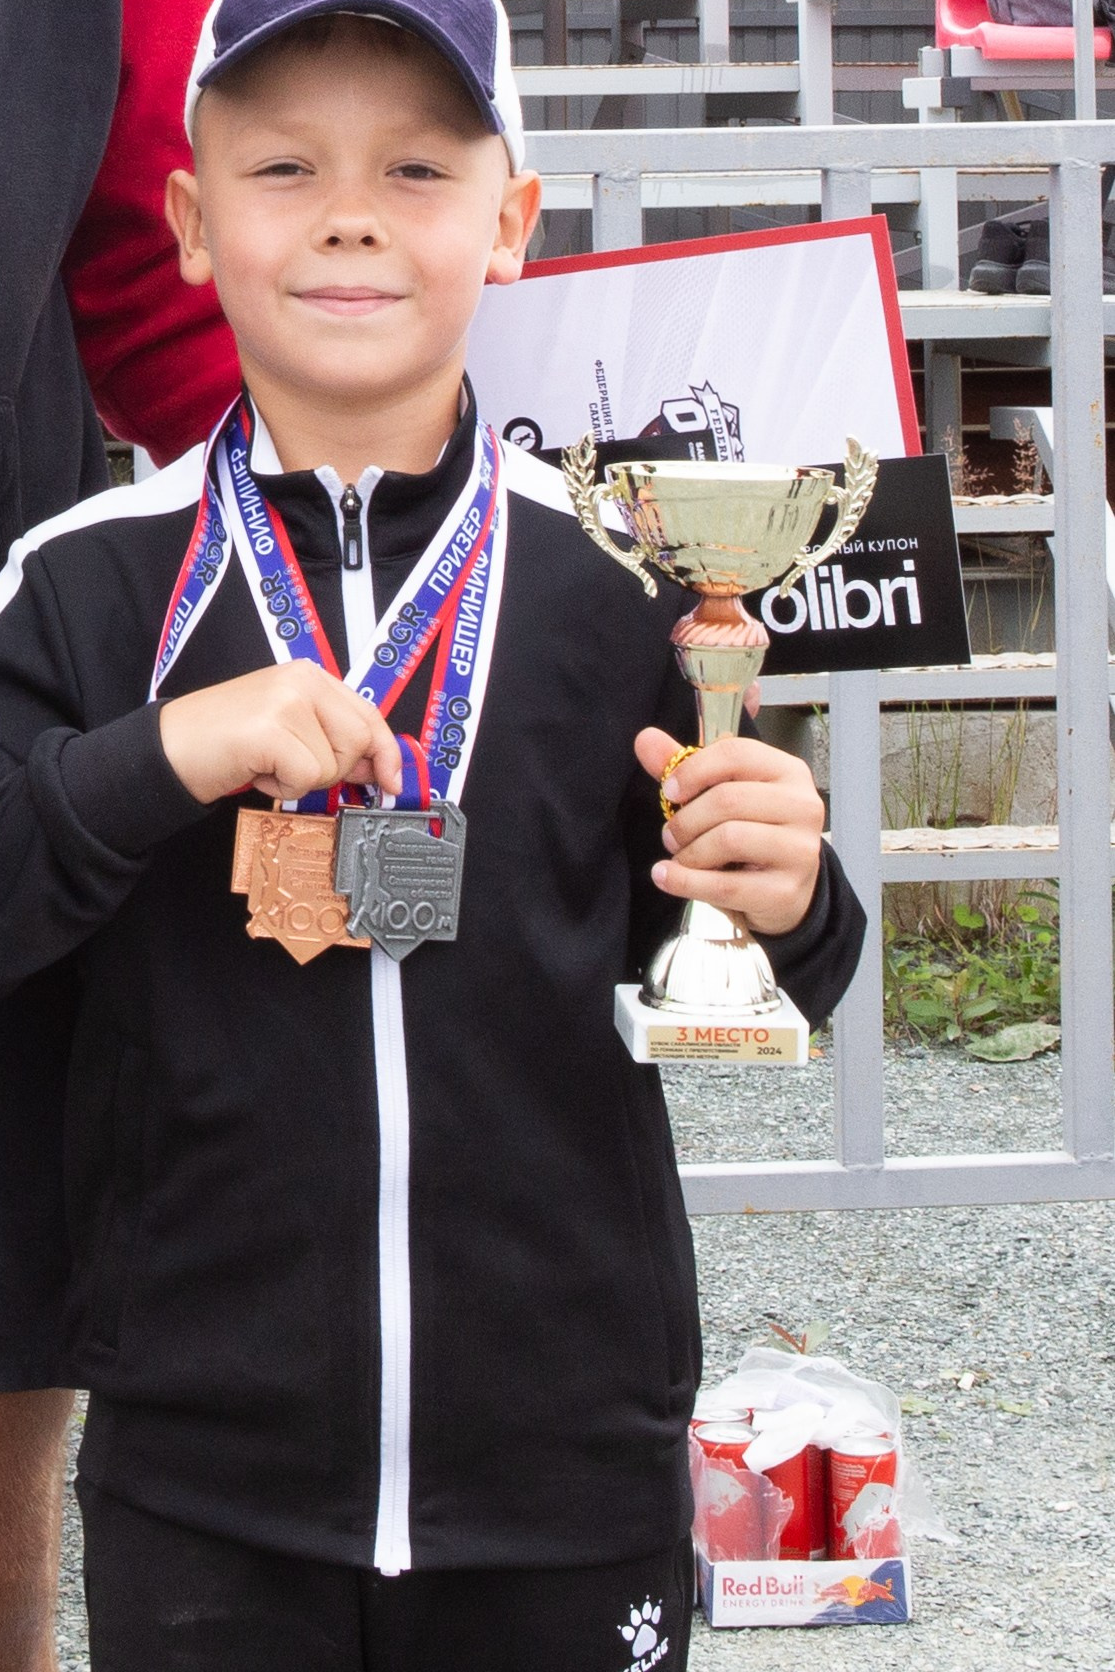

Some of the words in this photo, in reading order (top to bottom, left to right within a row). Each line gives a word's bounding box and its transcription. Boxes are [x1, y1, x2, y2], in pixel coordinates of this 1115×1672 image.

[593, 359, 613, 426] ФЕДЕРАЦИЯ
[588, 402, 604, 443] САХАЛИ
[709, 408, 729, 462] FEDERA
[868, 537, 919, 553] КУПОН
[258, 570, 301, 642] OCR
[449, 550, 490, 676] ФИНИШЕР
[760, 559, 922, 635] olibri
[373, 601, 427, 668] OCR
[435, 695, 473, 771] OCR
[676, 1026, 688, 1042] 3
[695, 1026, 770, 1043] МЕСТО
[756, 1046, 783, 1056] 2024
[722, 1576, 762, 1596] Red
[766, 1575, 804, 1596] Bull
[722, 1599, 767, 1608] ENERGY
[771, 1599, 804, 1607] DRINK
